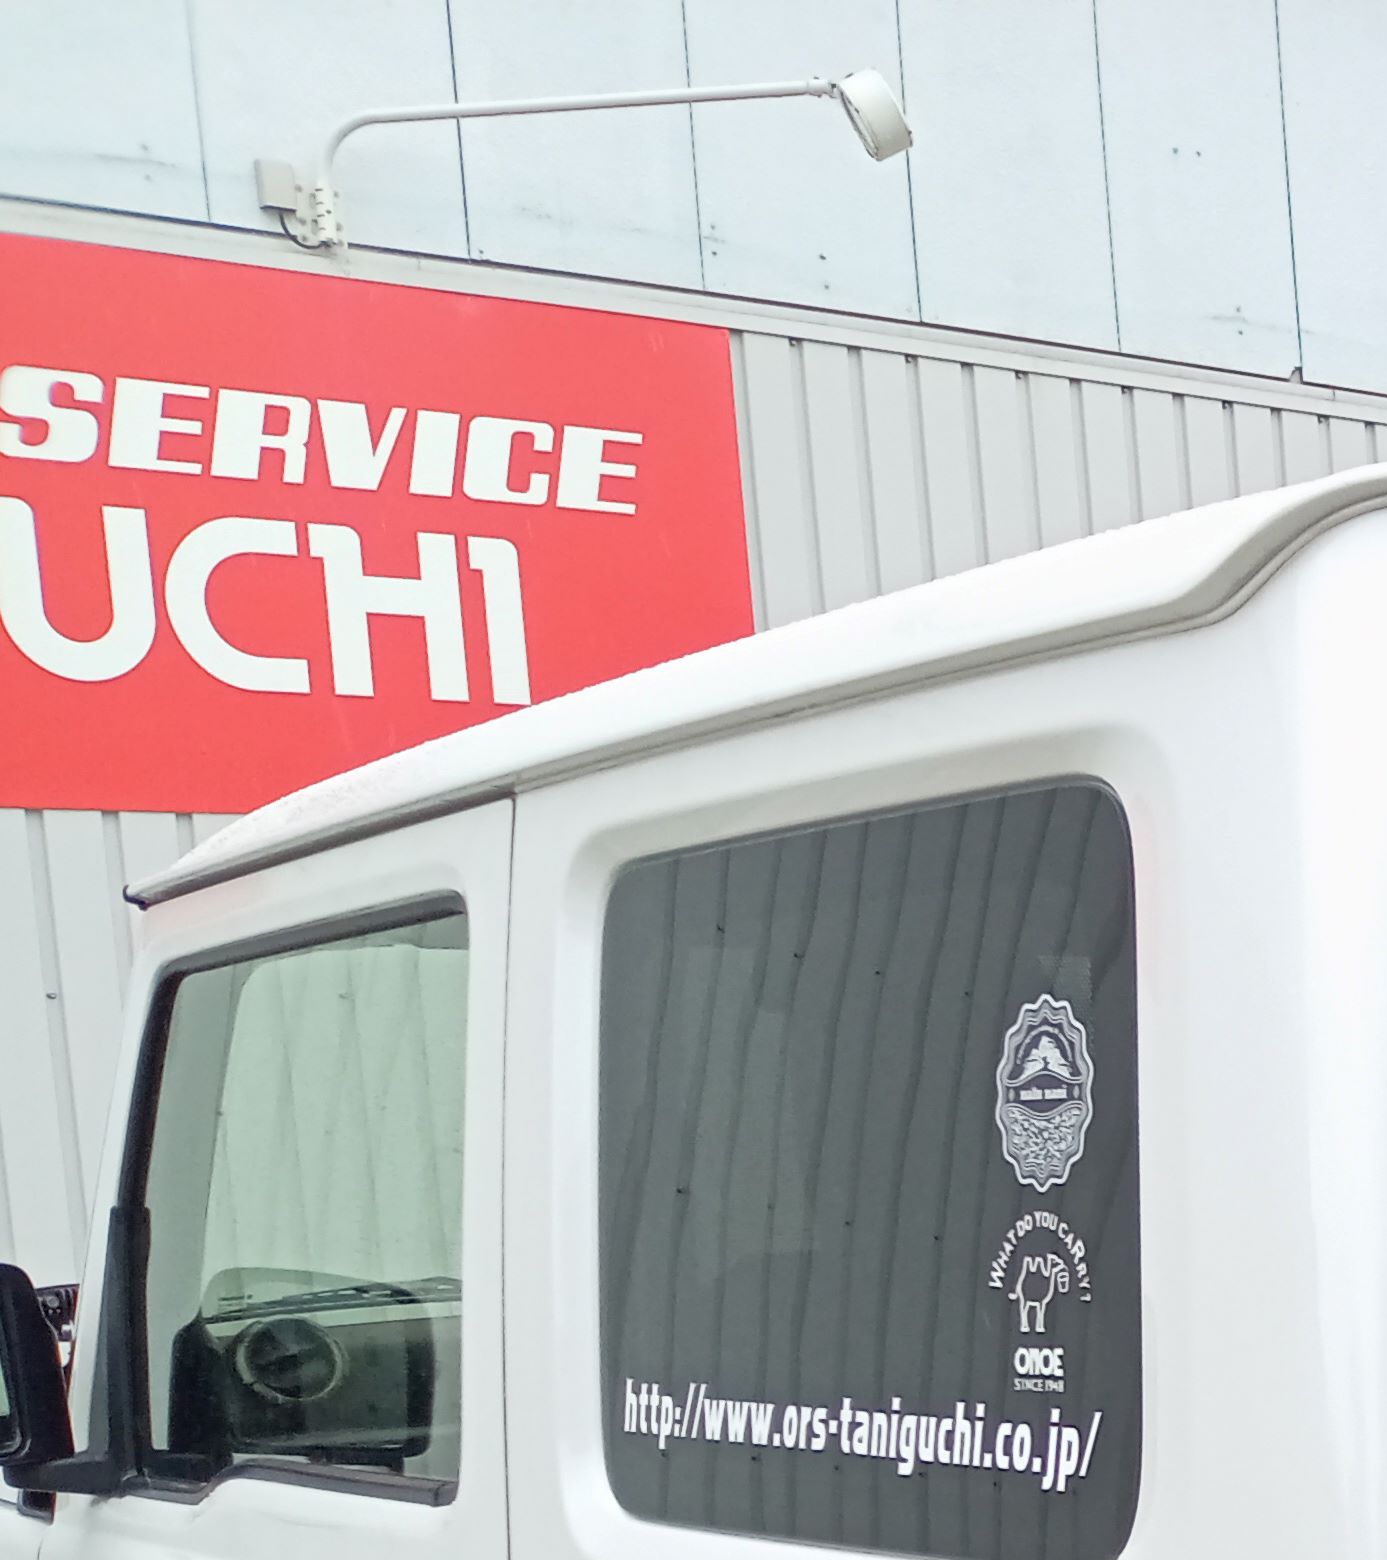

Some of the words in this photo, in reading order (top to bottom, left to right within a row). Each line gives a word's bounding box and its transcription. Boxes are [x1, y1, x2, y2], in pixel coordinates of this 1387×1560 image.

[0, 364, 644, 515] SERVICE
[0, 496, 532, 706] UCHI
[988, 1229, 1018, 1289] WHAT
[1015, 1214, 1033, 1237] DO
[1033, 1211, 1059, 1231] YOU
[624, 1377, 1103, 1492] http://www.ors-taniguchi.co.jp/
